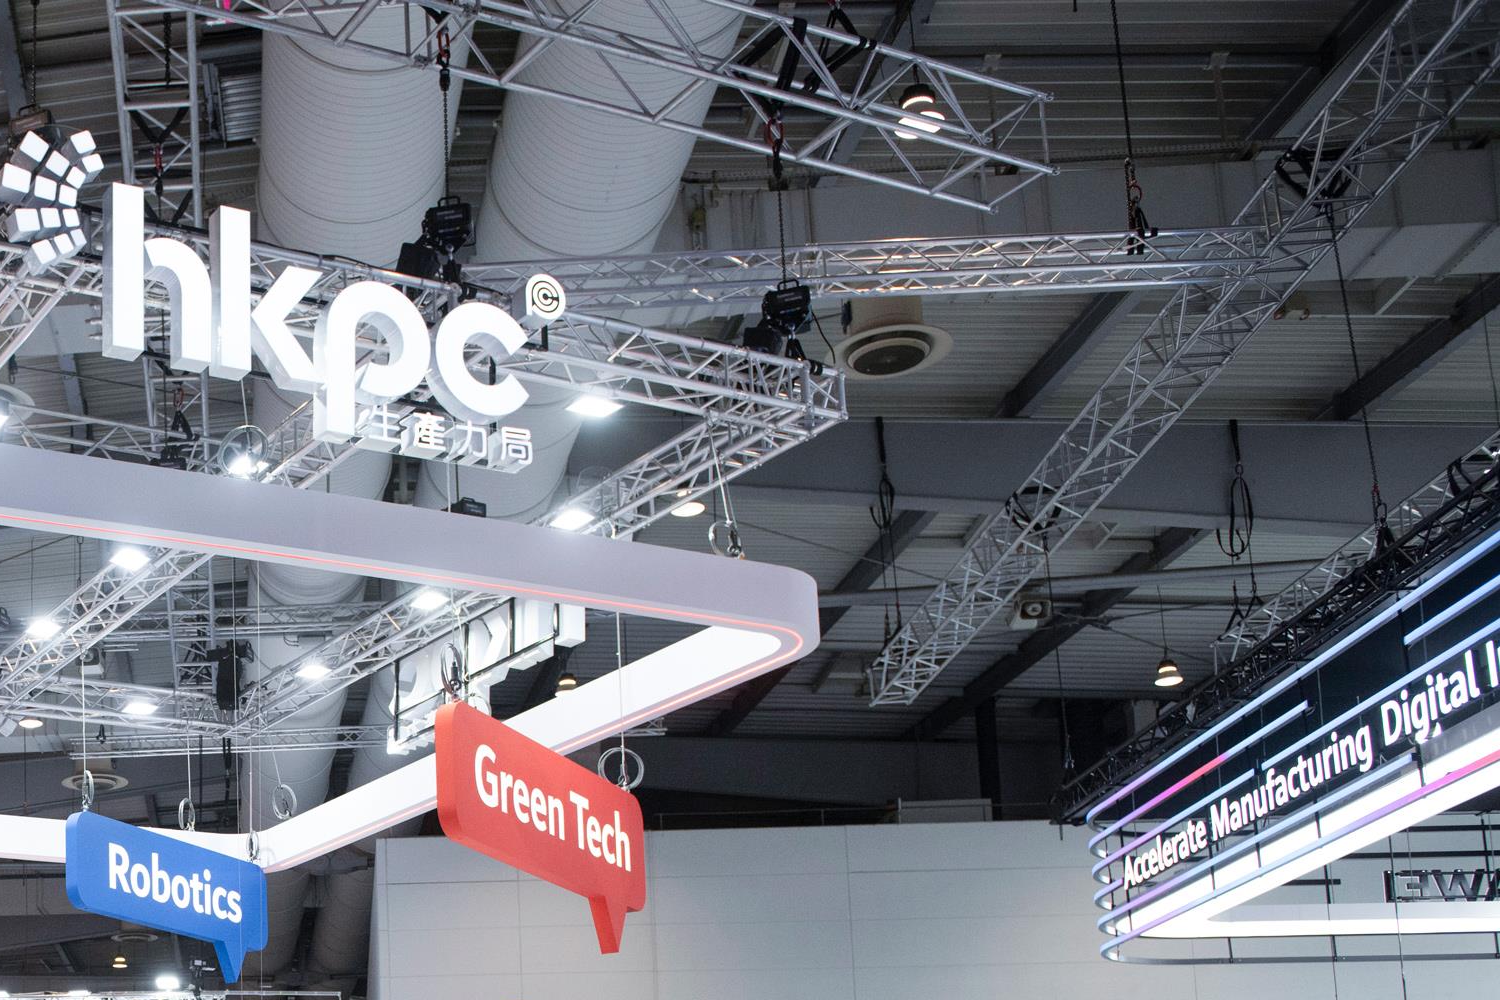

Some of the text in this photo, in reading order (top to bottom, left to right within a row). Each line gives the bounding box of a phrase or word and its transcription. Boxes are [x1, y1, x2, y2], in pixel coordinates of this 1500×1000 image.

[105, 183, 530, 443] hkpc
[366, 403, 533, 465] 生產力局
[475, 744, 631, 872] Green Tech
[1123, 640, 1500, 890] Accelerate Manufacturing Digital I
[108, 842, 242, 923] Robotics
